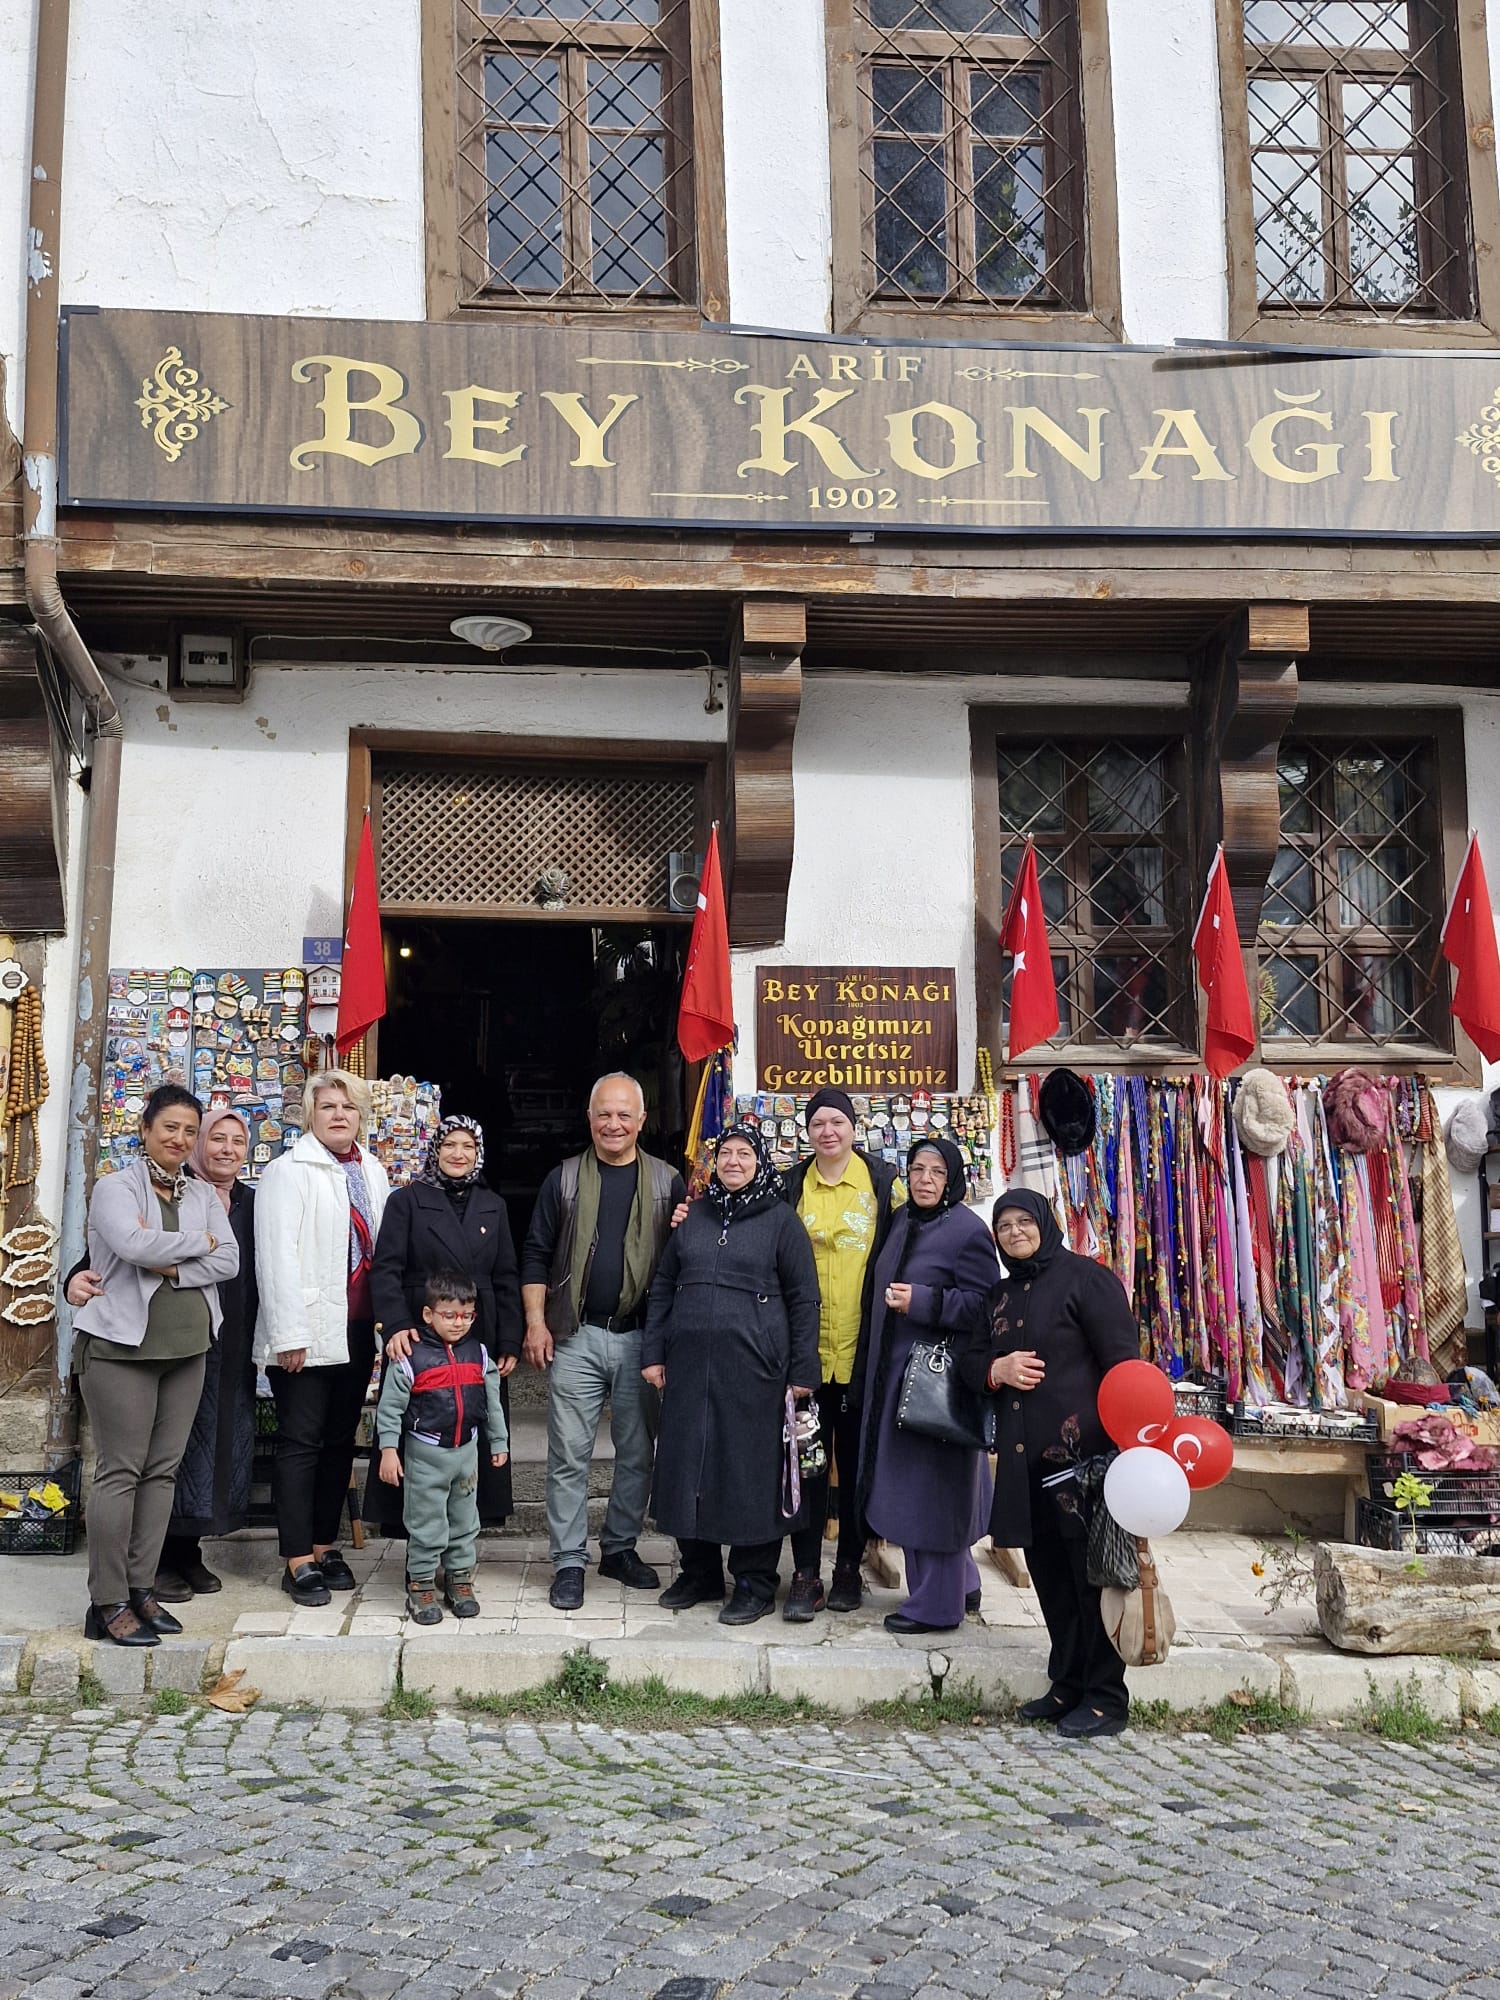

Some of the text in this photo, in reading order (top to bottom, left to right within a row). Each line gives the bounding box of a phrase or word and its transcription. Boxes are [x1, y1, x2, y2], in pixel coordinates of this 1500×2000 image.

[786, 349, 924, 383] ARİF
[290, 355, 1400, 485] BEY KONAĞI
[808, 486, 899, 510] 1902
[313, 941, 331, 956] 38
[763, 979, 951, 1003] BEY KONAĞI
[777, 1014, 932, 1039] Konağımızı
[798, 1034, 913, 1060] Ücretsiz
[763, 1063, 947, 1092] Gezebilirsiniz
